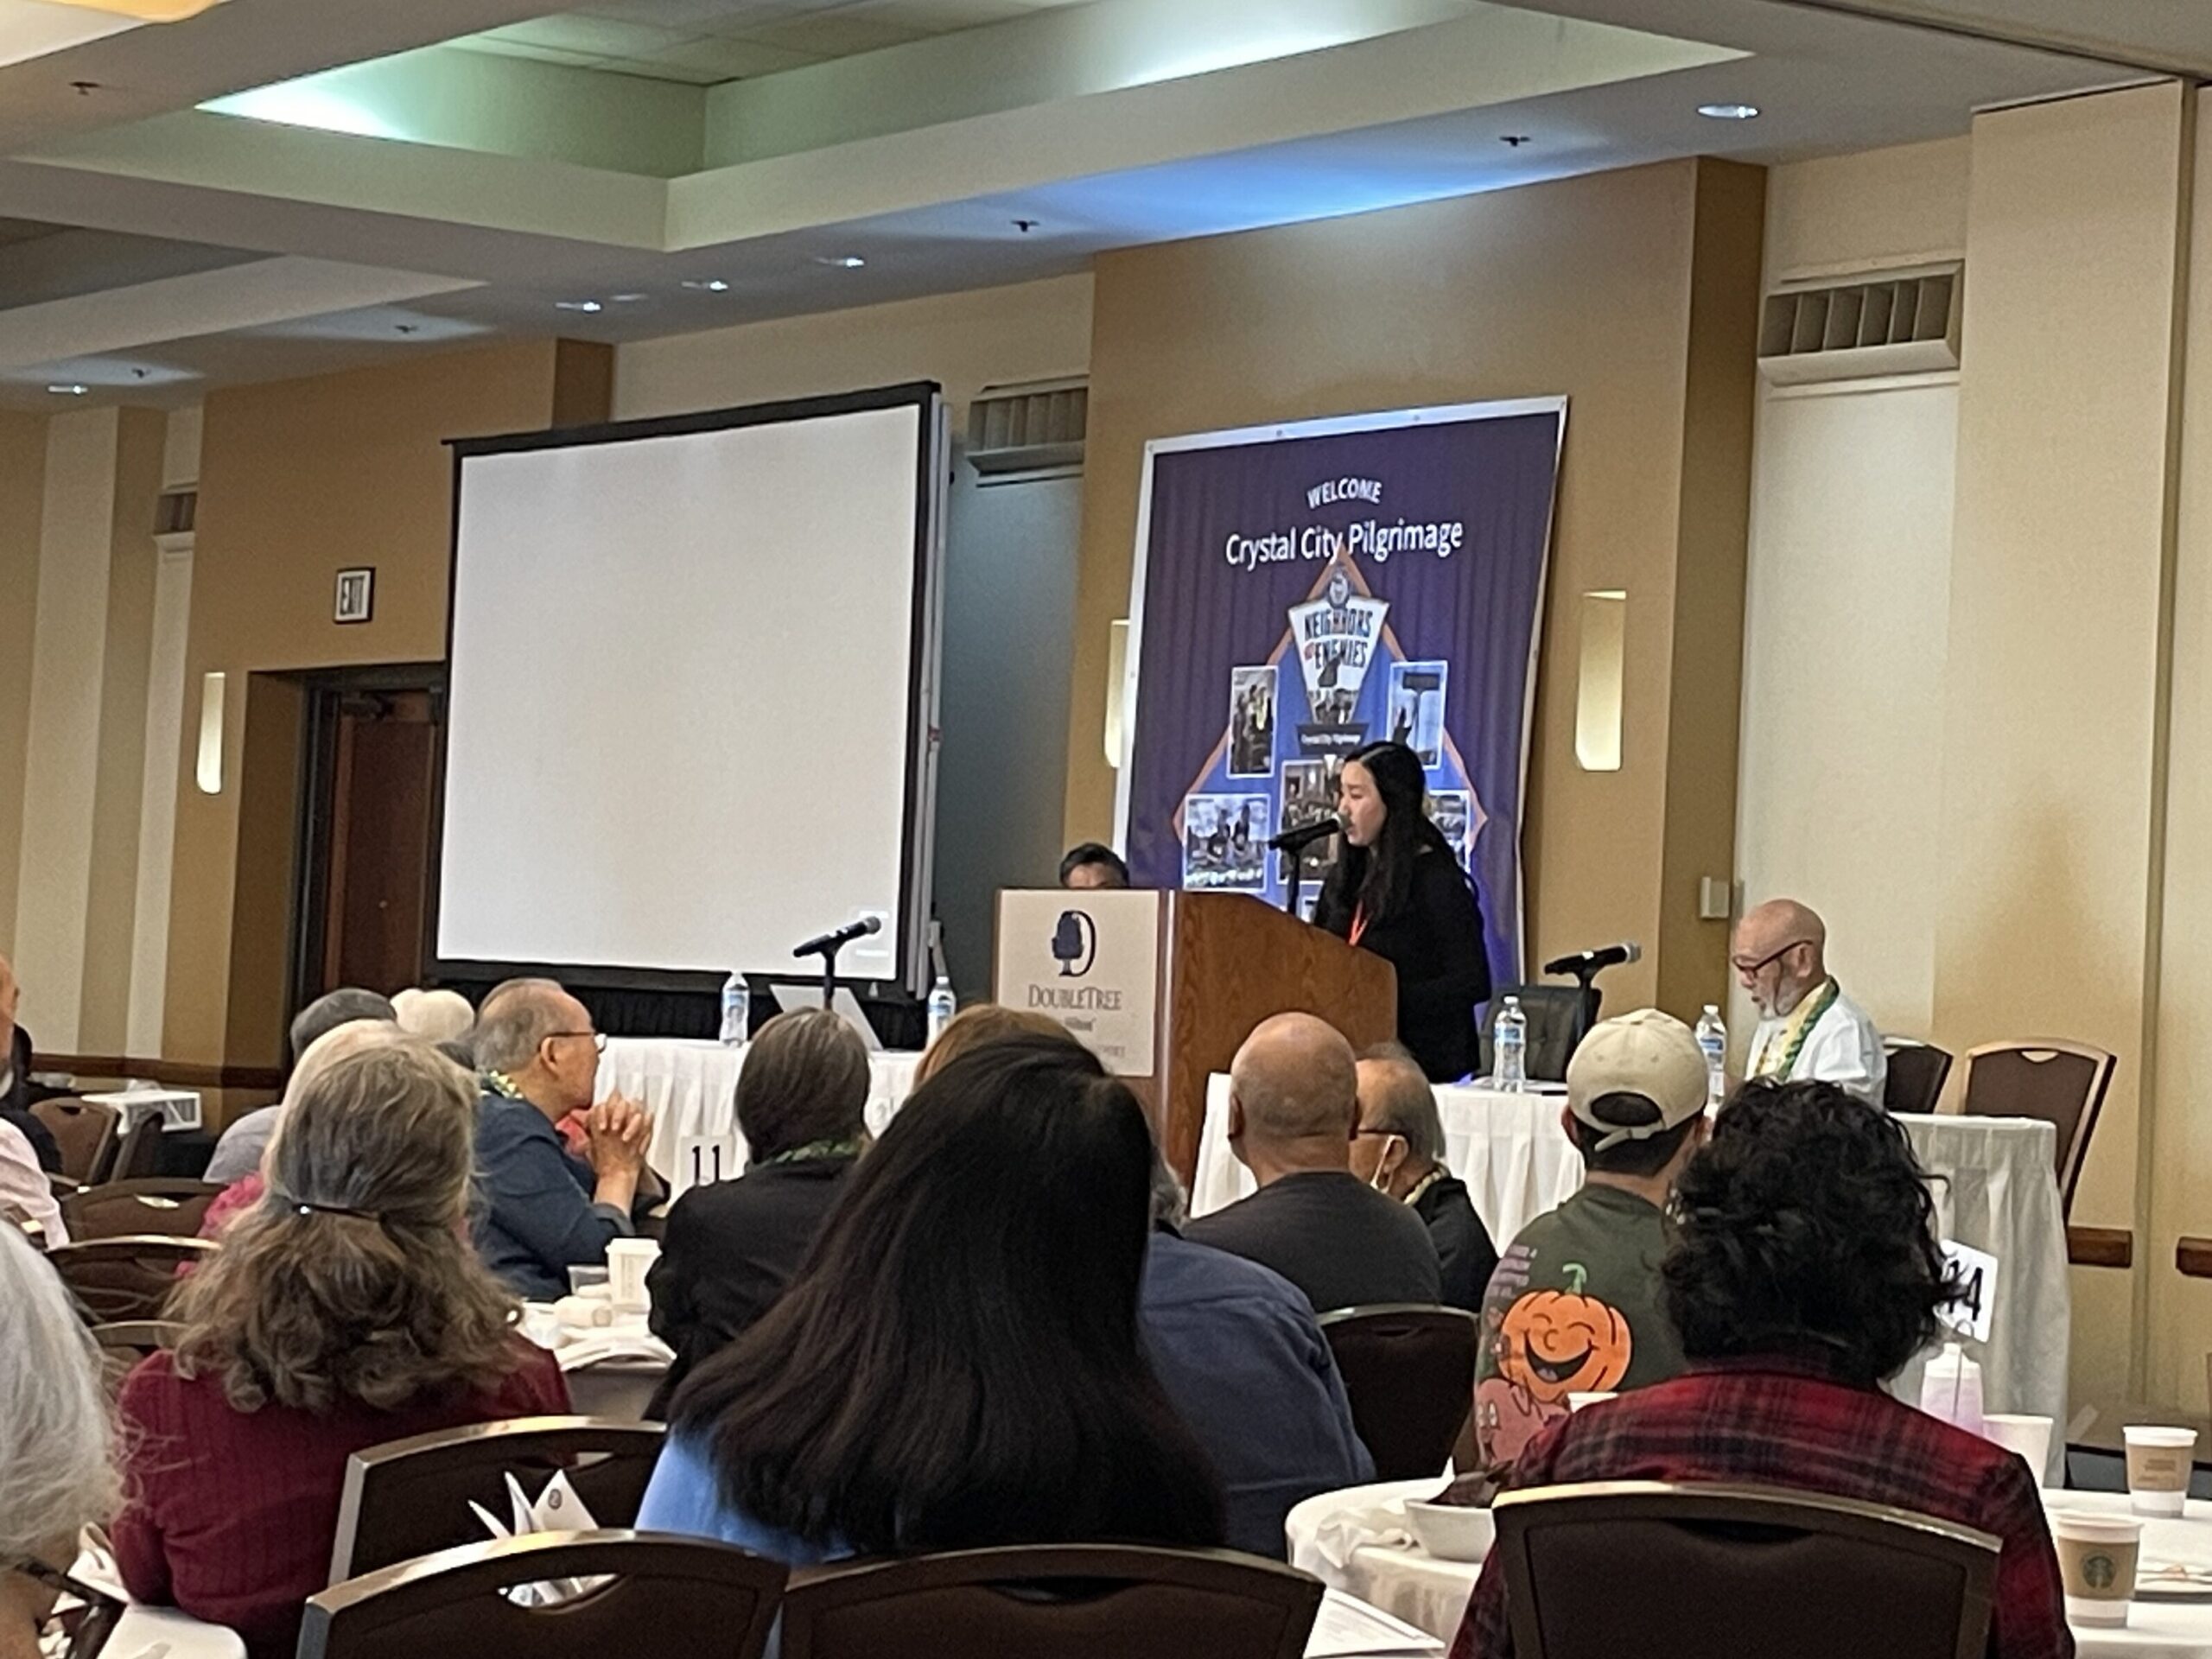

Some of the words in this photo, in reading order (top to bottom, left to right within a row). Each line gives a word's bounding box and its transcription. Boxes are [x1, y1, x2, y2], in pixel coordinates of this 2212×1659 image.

[1306, 477, 1382, 510] WELCOME
[1225, 526, 1296, 572] Crystal
[1300, 524, 1343, 565] City
[1348, 518, 1463, 563] Pilgrimage
[692, 1144, 721, 1185] 11
[1947, 1259, 1984, 1322] 14
